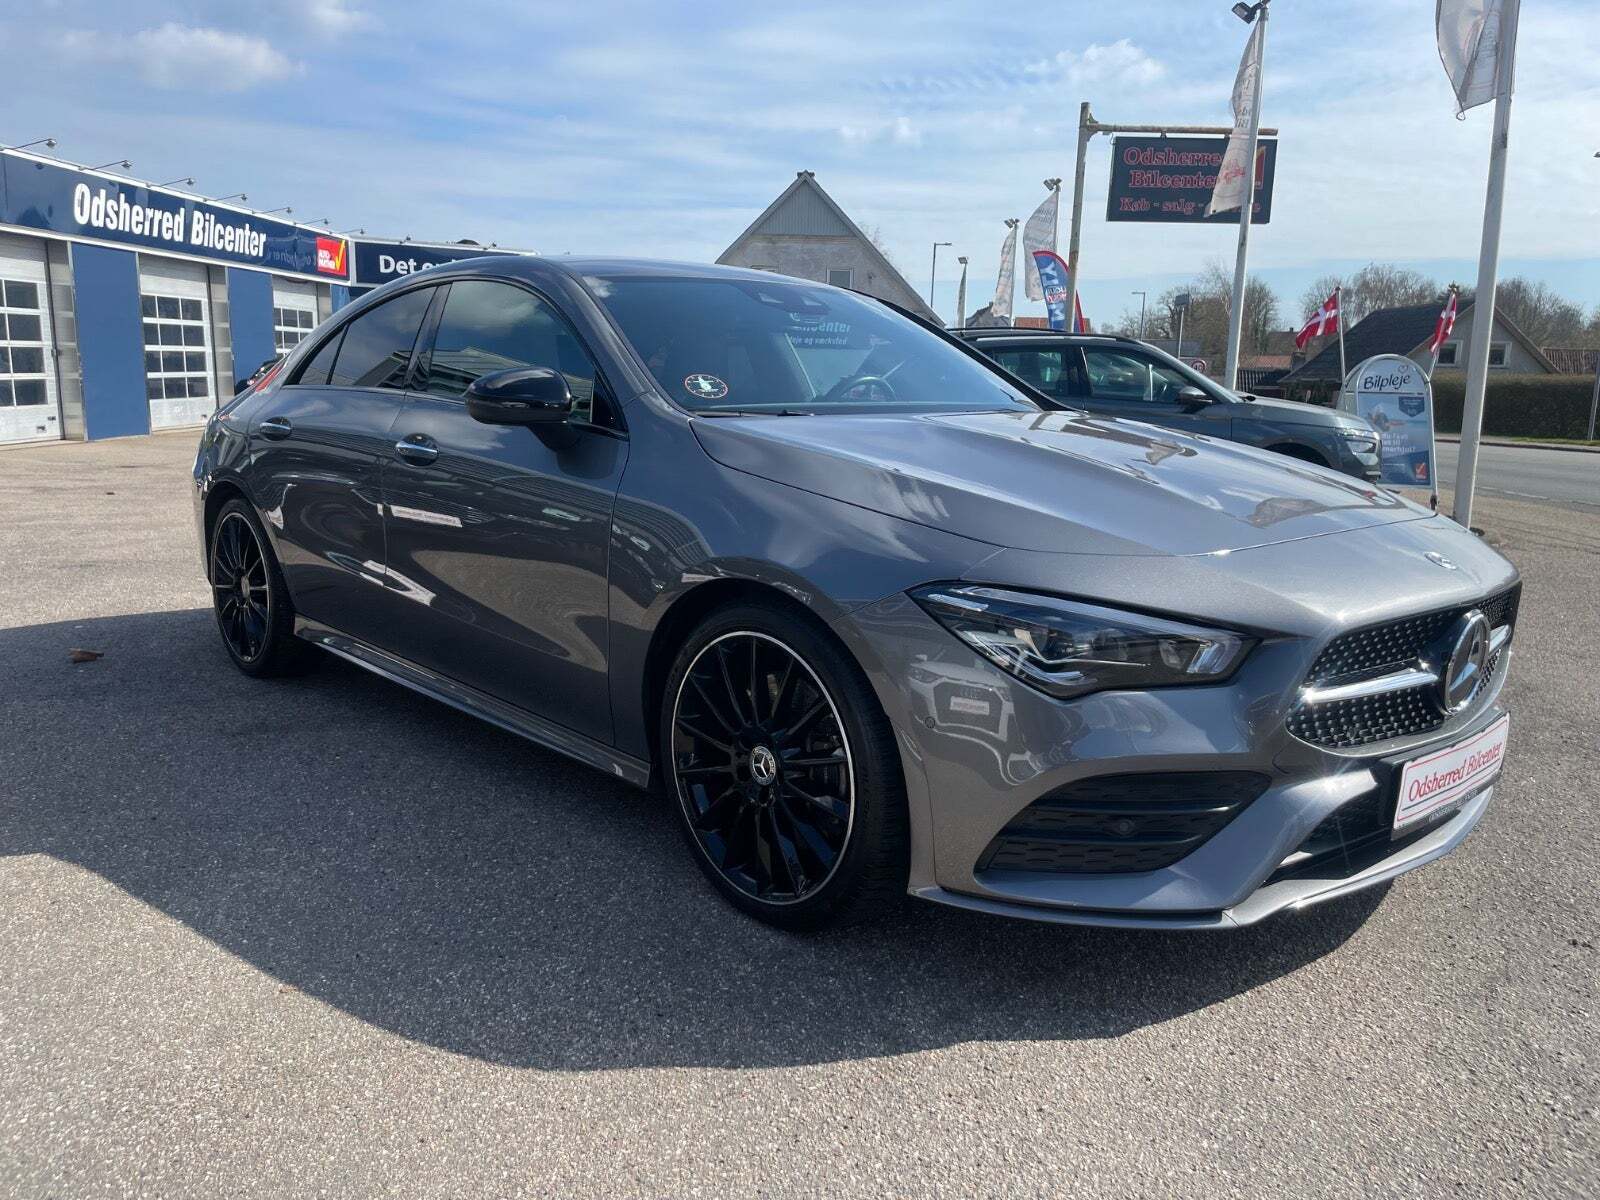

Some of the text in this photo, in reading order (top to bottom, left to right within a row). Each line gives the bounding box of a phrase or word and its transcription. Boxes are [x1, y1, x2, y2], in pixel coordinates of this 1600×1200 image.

[1123, 147, 1223, 166] Odsherre
[1161, 199, 1196, 215] salg
[73, 183, 267, 257] Odsherred Bilcenter
[379, 255, 417, 274] Det
[1363, 374, 1410, 391] Bilpleje
[1408, 742, 1503, 801] Odsherred Bilcenter
